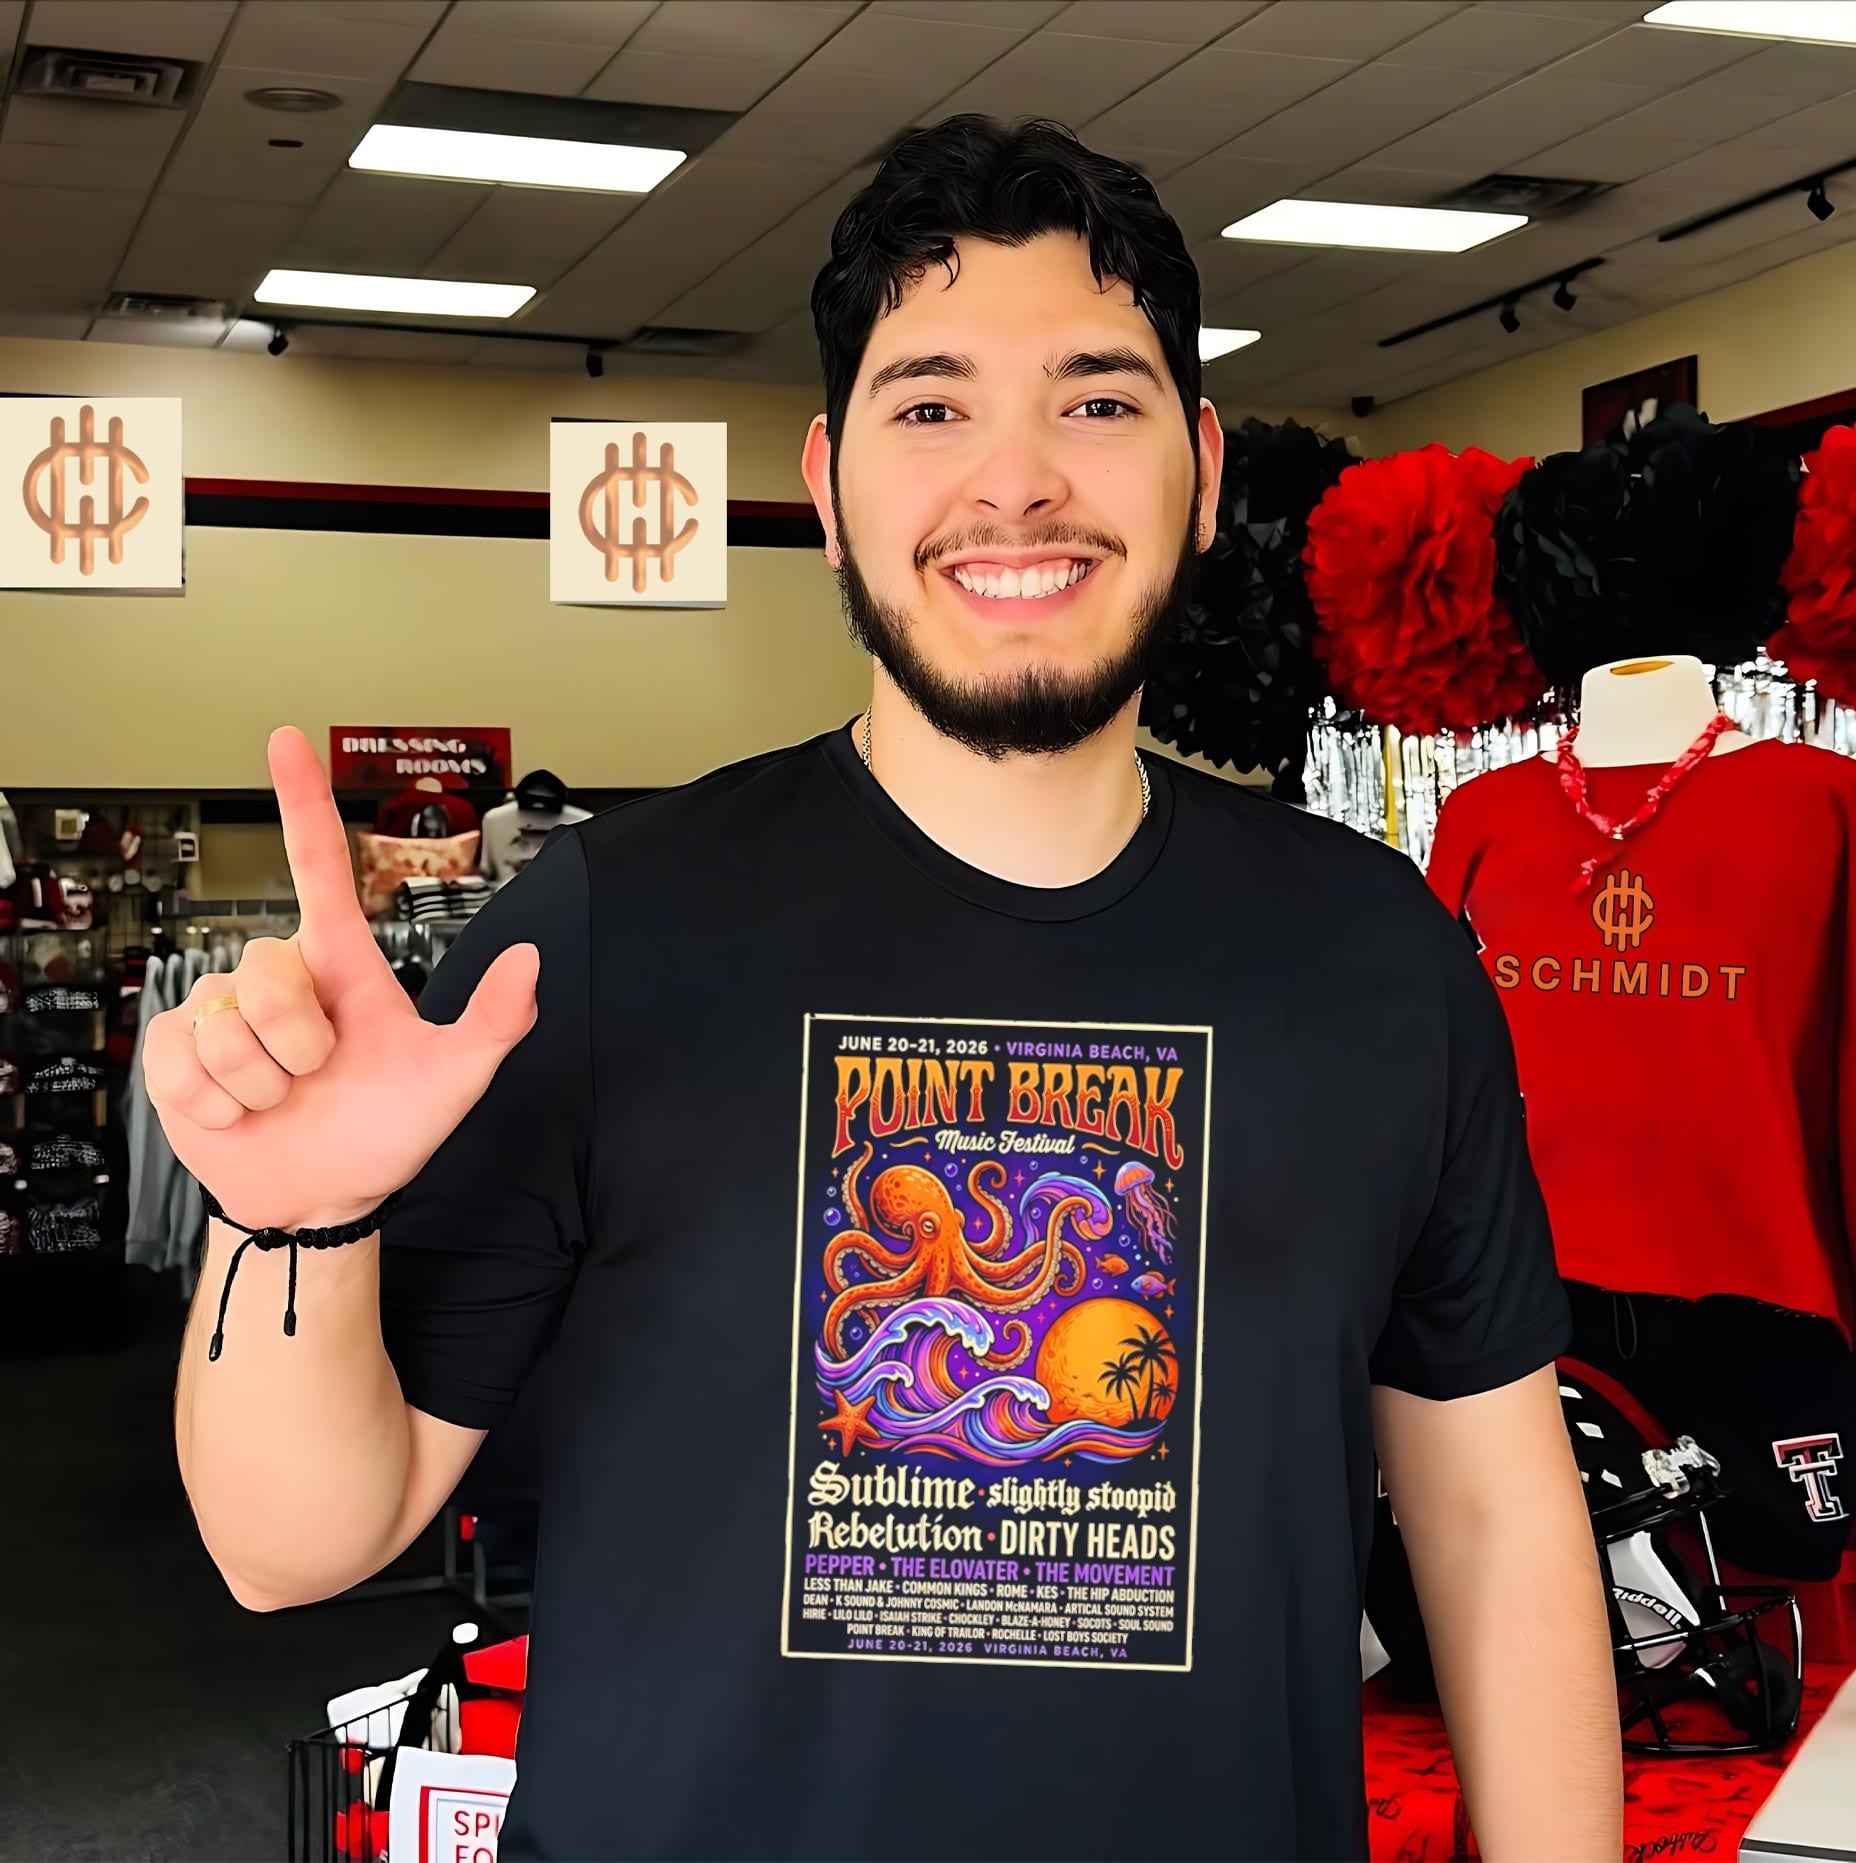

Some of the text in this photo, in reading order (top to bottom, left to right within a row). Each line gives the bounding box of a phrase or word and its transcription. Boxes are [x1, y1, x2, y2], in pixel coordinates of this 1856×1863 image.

[1494, 953, 1747, 1001] SCHMIDT
[838, 1035, 1178, 1063] JUNE 20-21, 2026 VIRGINIA BEACH, VA
[831, 1055, 1184, 1170] POINT BREAK
[934, 1128, 1076, 1155] Music Festival
[807, 1459, 1177, 1519] Sublime slightly stoopid
[807, 1510, 1176, 1561] Rebelution DIRTY HEADS
[804, 1553, 1175, 1587] PEPPER THE ELOVATER THE MOVEMENT
[803, 1577, 1175, 1603] LESS THAN JAKE COMMON KINGS ROME KES THE HIP ABDUCTION
[803, 1593, 1175, 1618] DEAN K SOUND & JOHNNY COSMIC LANDON McNAMARA ARTICAL SOUND SYSTEM
[802, 1607, 827, 1620] HIRIE
[833, 1608, 853, 1621] LILO
[853, 1609, 874, 1622] LILO
[879, 1610, 910, 1623] ISAIAH
[910, 1611, 943, 1624] STRIKE
[948, 1613, 995, 1625] CHOCKLEY
[1117, 1618, 1142, 1632] SOUL
[1142, 1619, 1174, 1632] SOUND
[846, 1623, 1129, 1645] POINT BREAK KING OF TRAILOR ROCHELLE LOST BOYS SOCIETY
[847, 1638, 1128, 1659] JUNE 20-21, 2026 VIRGINIA BEACH, VA
